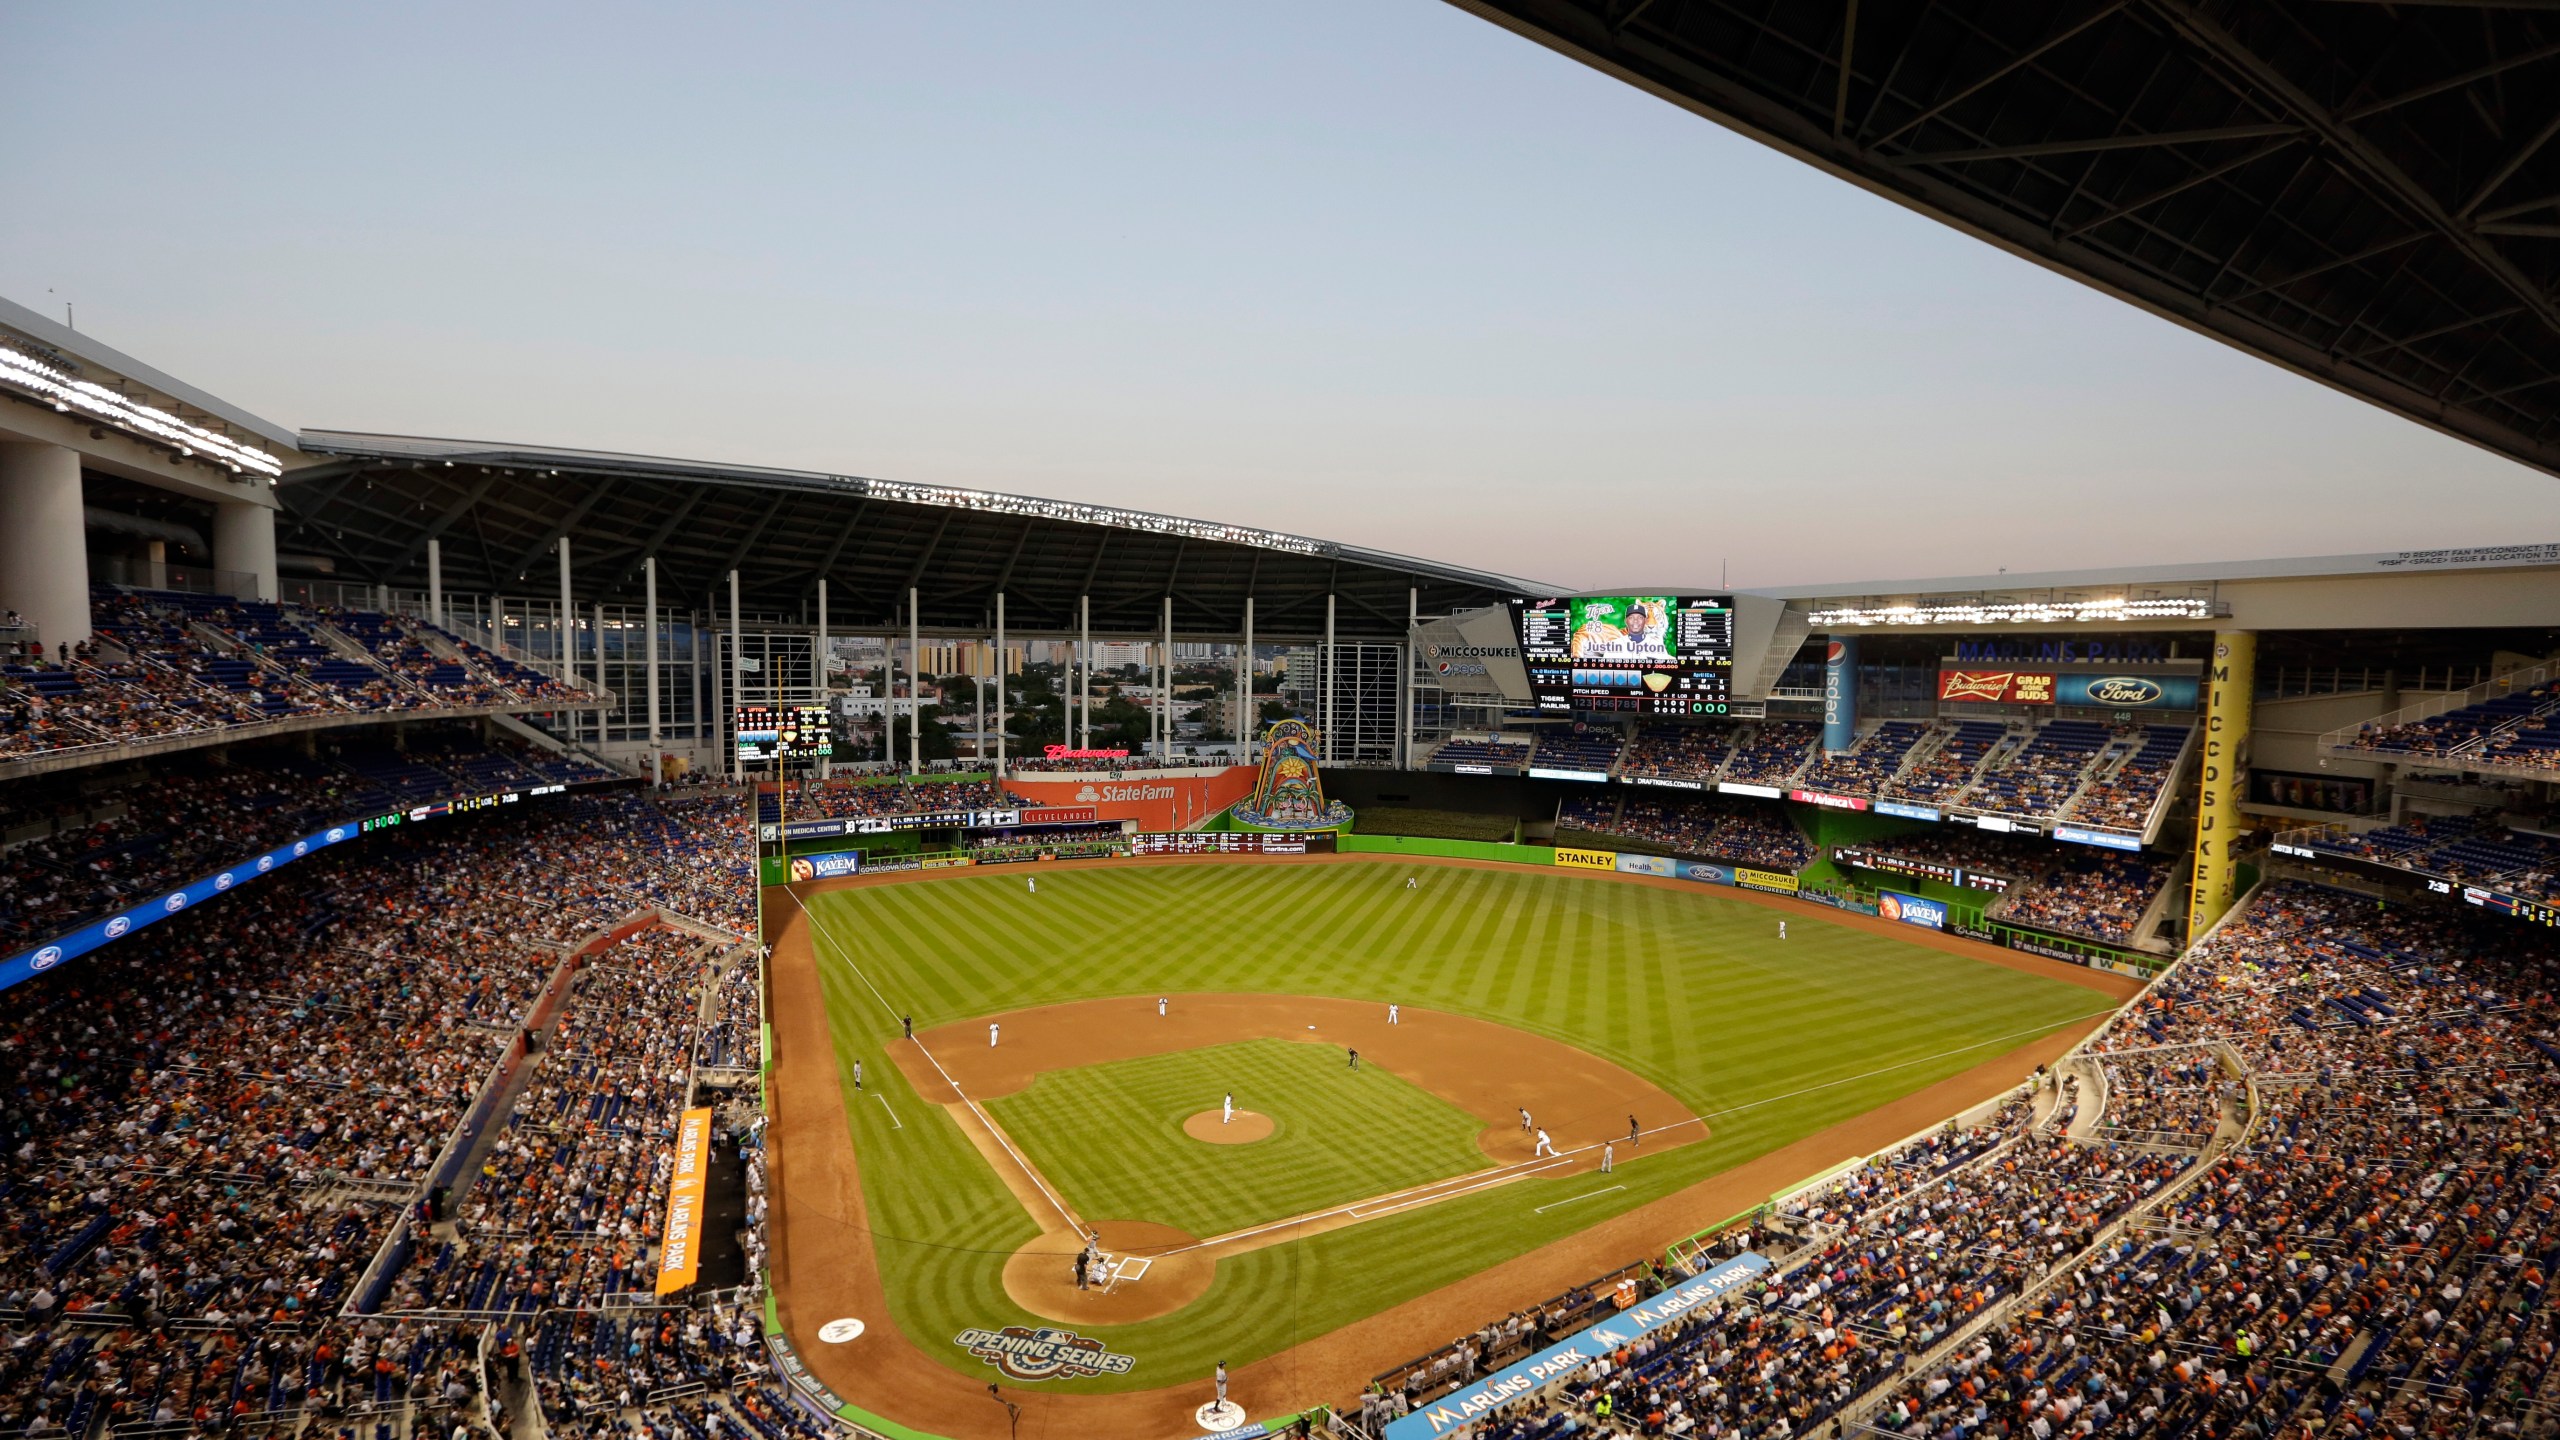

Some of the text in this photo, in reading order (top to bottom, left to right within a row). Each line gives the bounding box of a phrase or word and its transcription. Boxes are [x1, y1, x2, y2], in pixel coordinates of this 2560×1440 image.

[2474, 546, 2543, 555] MISCONDUCT:
[2490, 552, 2541, 561] LOCATION
[1586, 604, 1615, 621] Tigers
[1586, 621, 1602, 633] #8
[1440, 646, 1516, 657] MICCOSUKEE
[1587, 642, 1664, 654] Justin Upton
[1958, 642, 2166, 664] MARLINS PARK
[1452, 664, 1486, 676] pepsi
[1946, 678, 2009, 691] Budweiser
[2016, 676, 2051, 685] GRAB
[1825, 672, 1841, 724] pepsi
[2016, 691, 2050, 701] BUDS
[2100, 681, 2145, 702] Ford
[2114, 712, 2132, 722] 448
[1589, 725, 1615, 734] pepsi
[1044, 744, 1130, 760] Budweiser
[1638, 778, 1701, 789] DRAFTKINGS.COM/MLB
[2196, 665, 2230, 905] MICCOSUKEE
[531, 786, 548, 795] JUSTIN
[481, 798, 492, 806] LOB
[502, 793, 518, 803] 7:38
[1802, 792, 1848, 808] Fly Avianca
[1025, 812, 1092, 822] CLEVELANDER
[363, 818, 380, 831] B S
[793, 826, 816, 834] MEDICAL
[2271, 844, 2293, 854] JUSTIN
[1558, 852, 1612, 866] STANLEY
[816, 858, 856, 876] KAYEM
[1694, 866, 1716, 879] Ford
[1750, 872, 1796, 884] MICCOSUKEE
[1740, 882, 1795, 896] #MICCOSUKEELIFE
[2428, 880, 2450, 894] 7:38
[1902, 904, 1943, 927] KAYEM
[2522, 906, 2545, 921] H E
[1964, 929, 1993, 941] LEXUS
[2023, 944, 2074, 960] MLB NETWORK
[678, 1118, 702, 1174] MARLINS PARK
[665, 1195, 694, 1272] MARLINS PARK
[1630, 1264, 1756, 1328] MARLINS PARK
[957, 1330, 1131, 1372] OPENING SERIES
[1425, 1348, 1588, 1434] MARLINS PARK
[1221, 1424, 1263, 1438] RICOH
